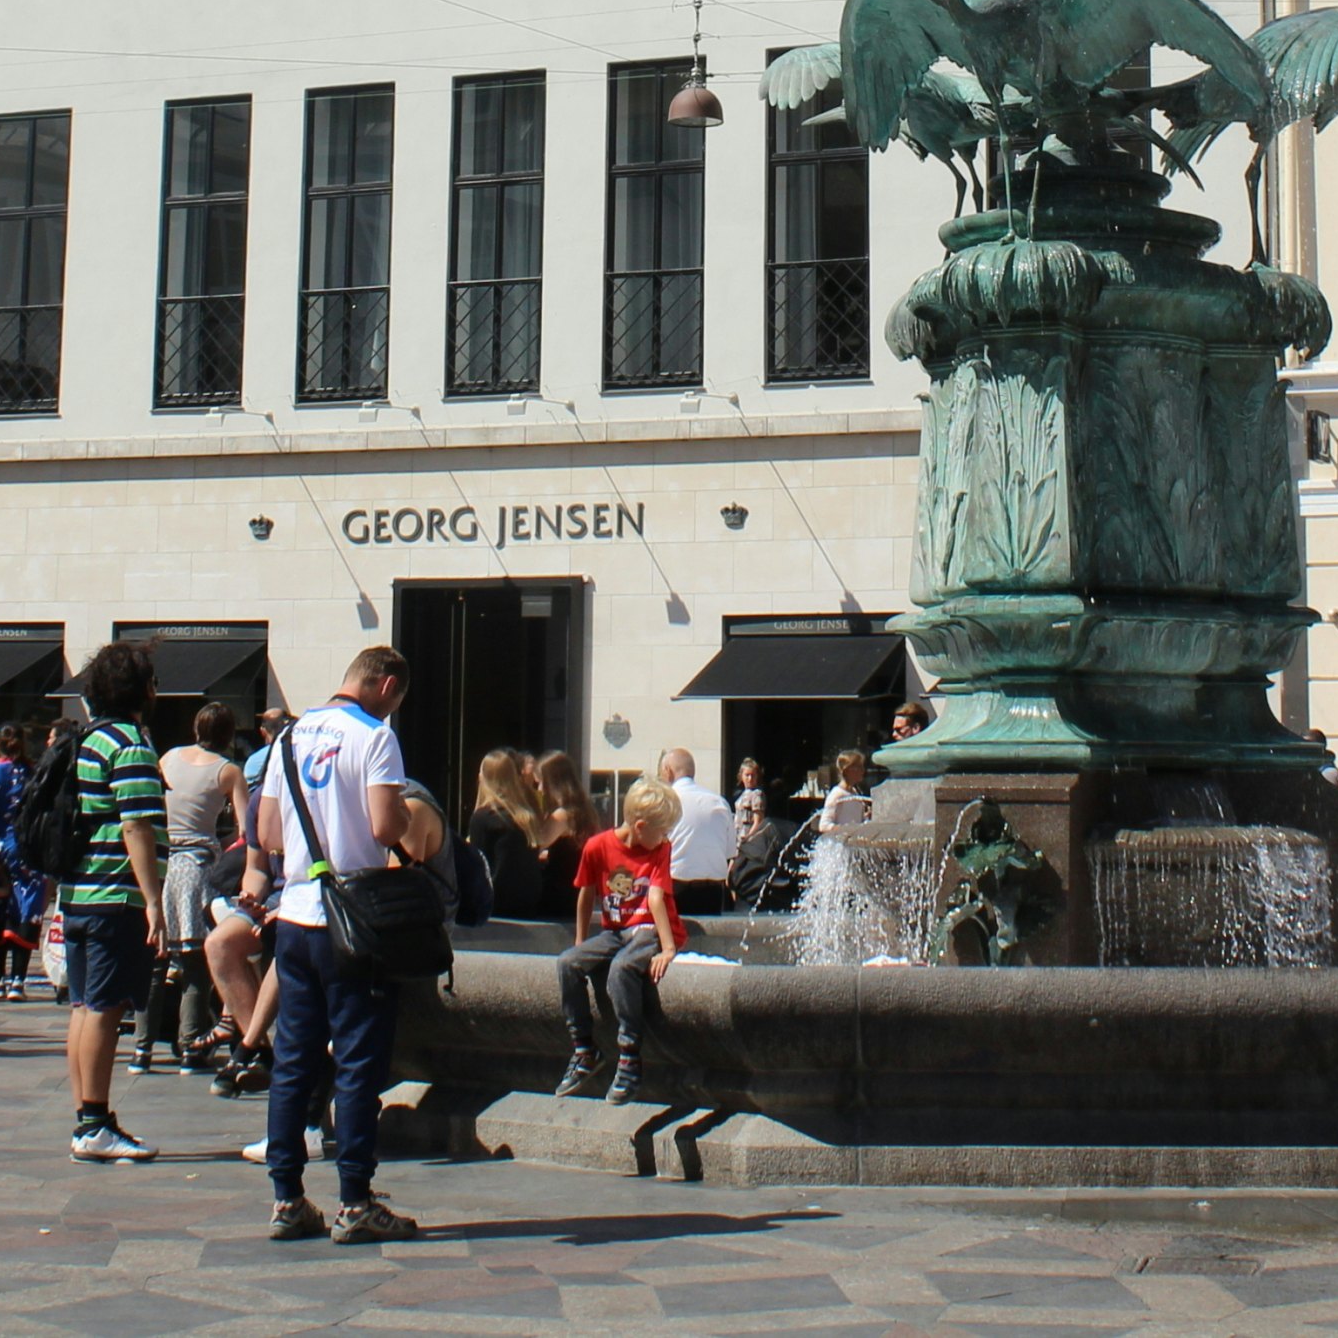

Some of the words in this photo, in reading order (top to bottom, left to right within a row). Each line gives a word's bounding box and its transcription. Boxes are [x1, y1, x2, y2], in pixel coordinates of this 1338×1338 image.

[342, 505, 479, 545] GEORG
[495, 502, 646, 550] JENSEN
[816, 619, 850, 632] JENSE
